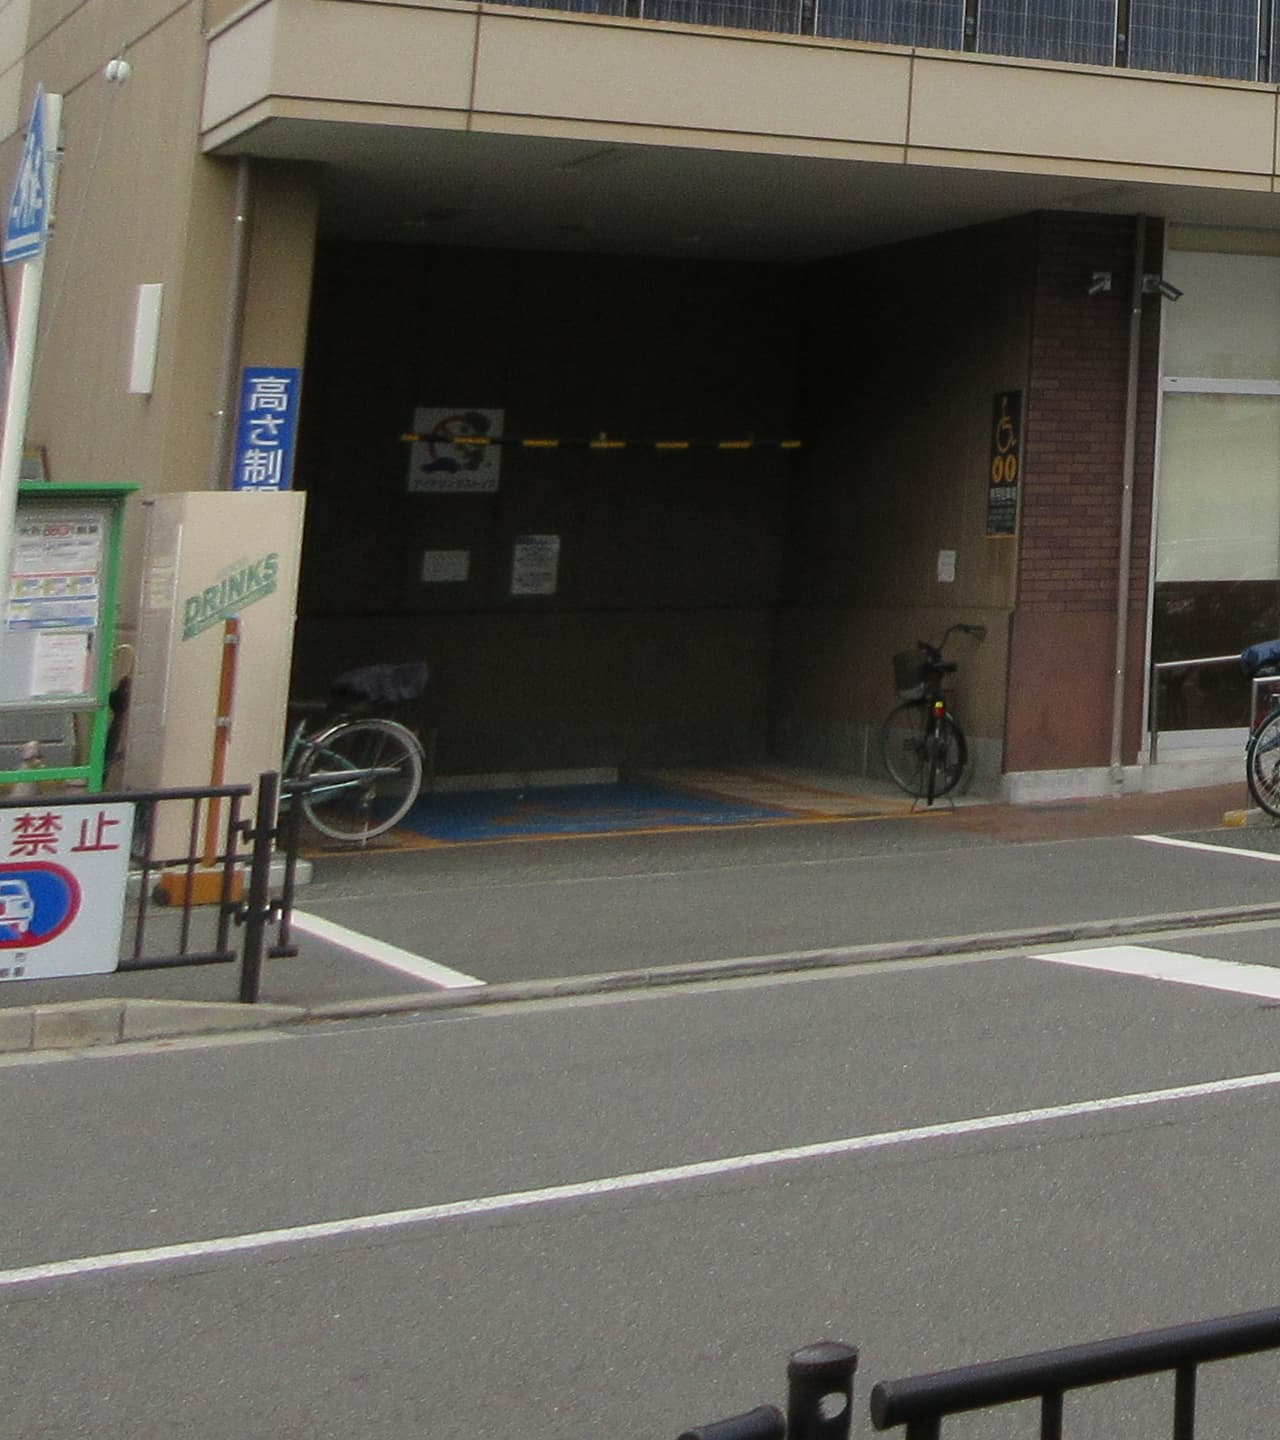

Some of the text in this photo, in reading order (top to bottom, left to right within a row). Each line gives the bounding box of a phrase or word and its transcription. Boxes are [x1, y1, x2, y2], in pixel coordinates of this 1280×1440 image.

[241, 376, 291, 492] 高さ制
[184, 552, 280, 626] DRINKS
